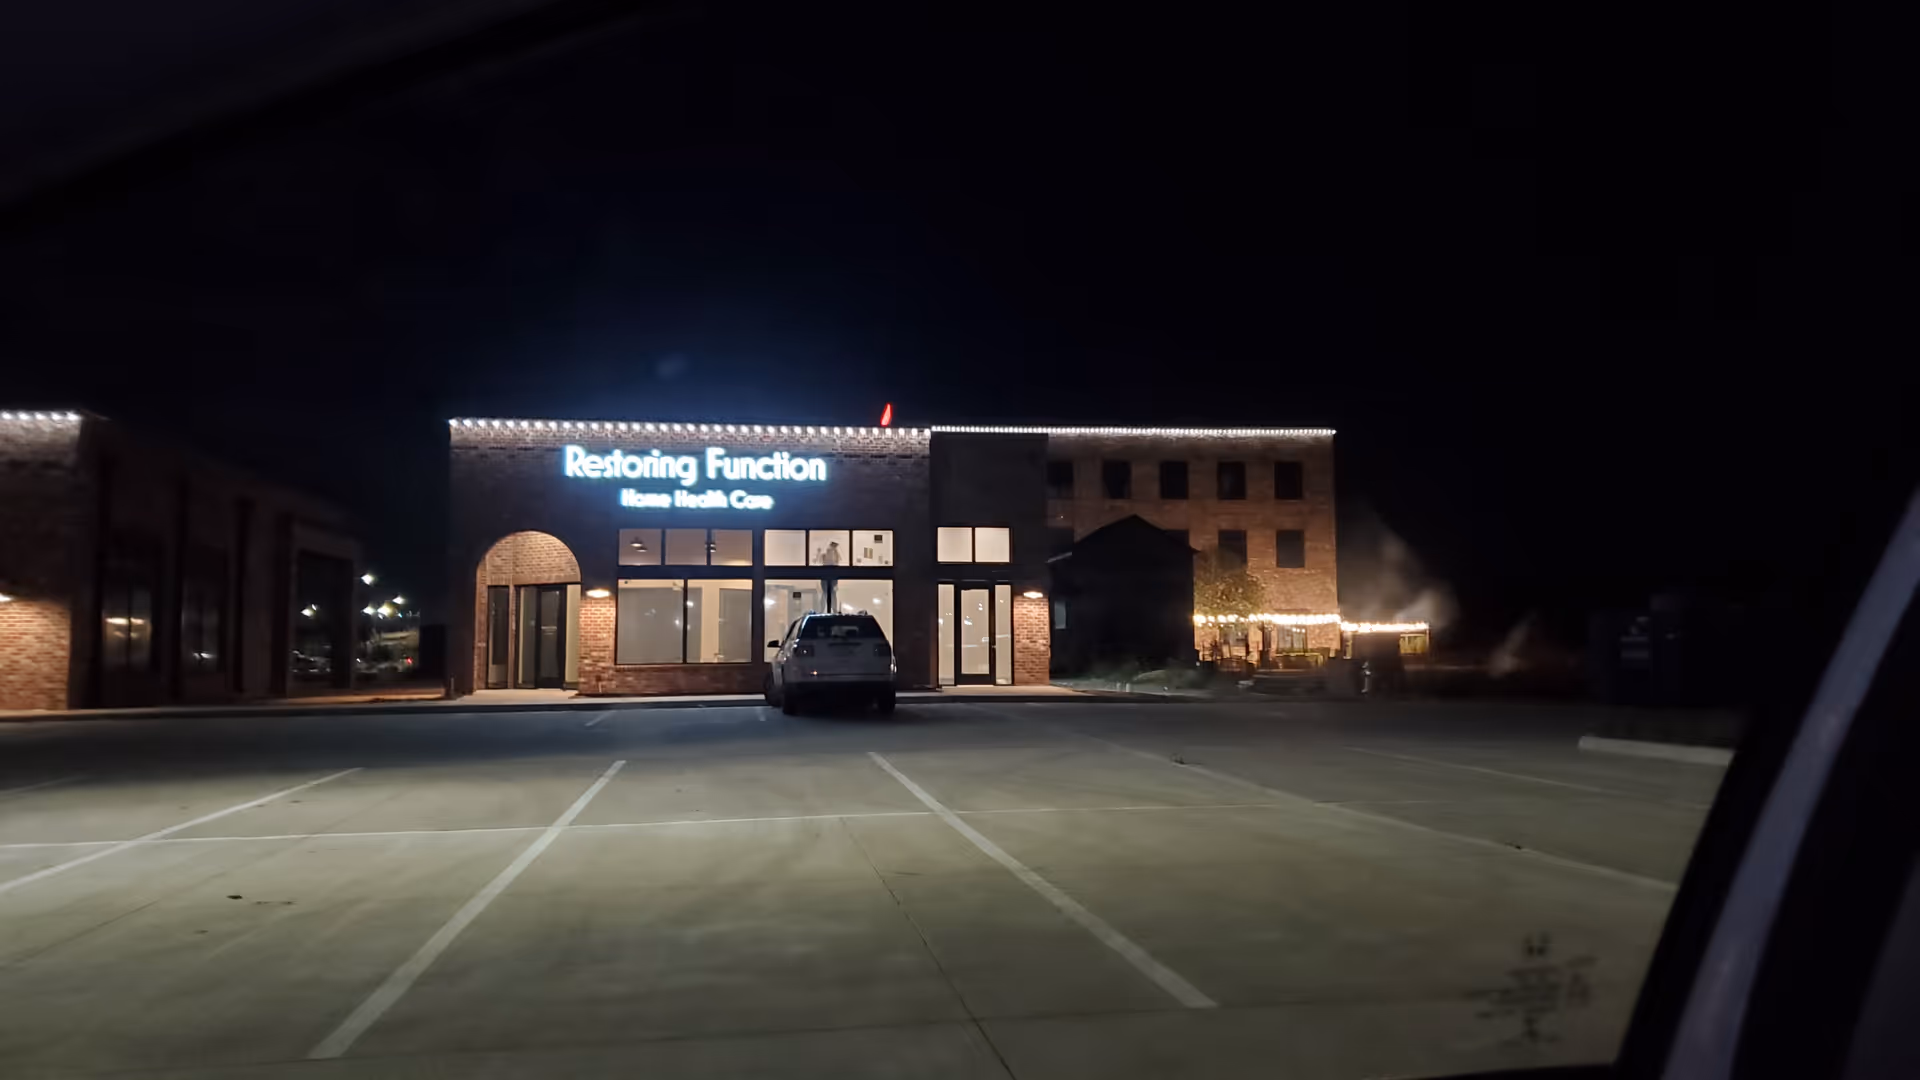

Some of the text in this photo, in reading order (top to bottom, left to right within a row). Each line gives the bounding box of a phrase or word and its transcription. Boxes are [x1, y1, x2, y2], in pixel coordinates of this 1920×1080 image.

[564, 445, 827, 487] Restoring Function
[620, 488, 774, 509] Home Health Care
